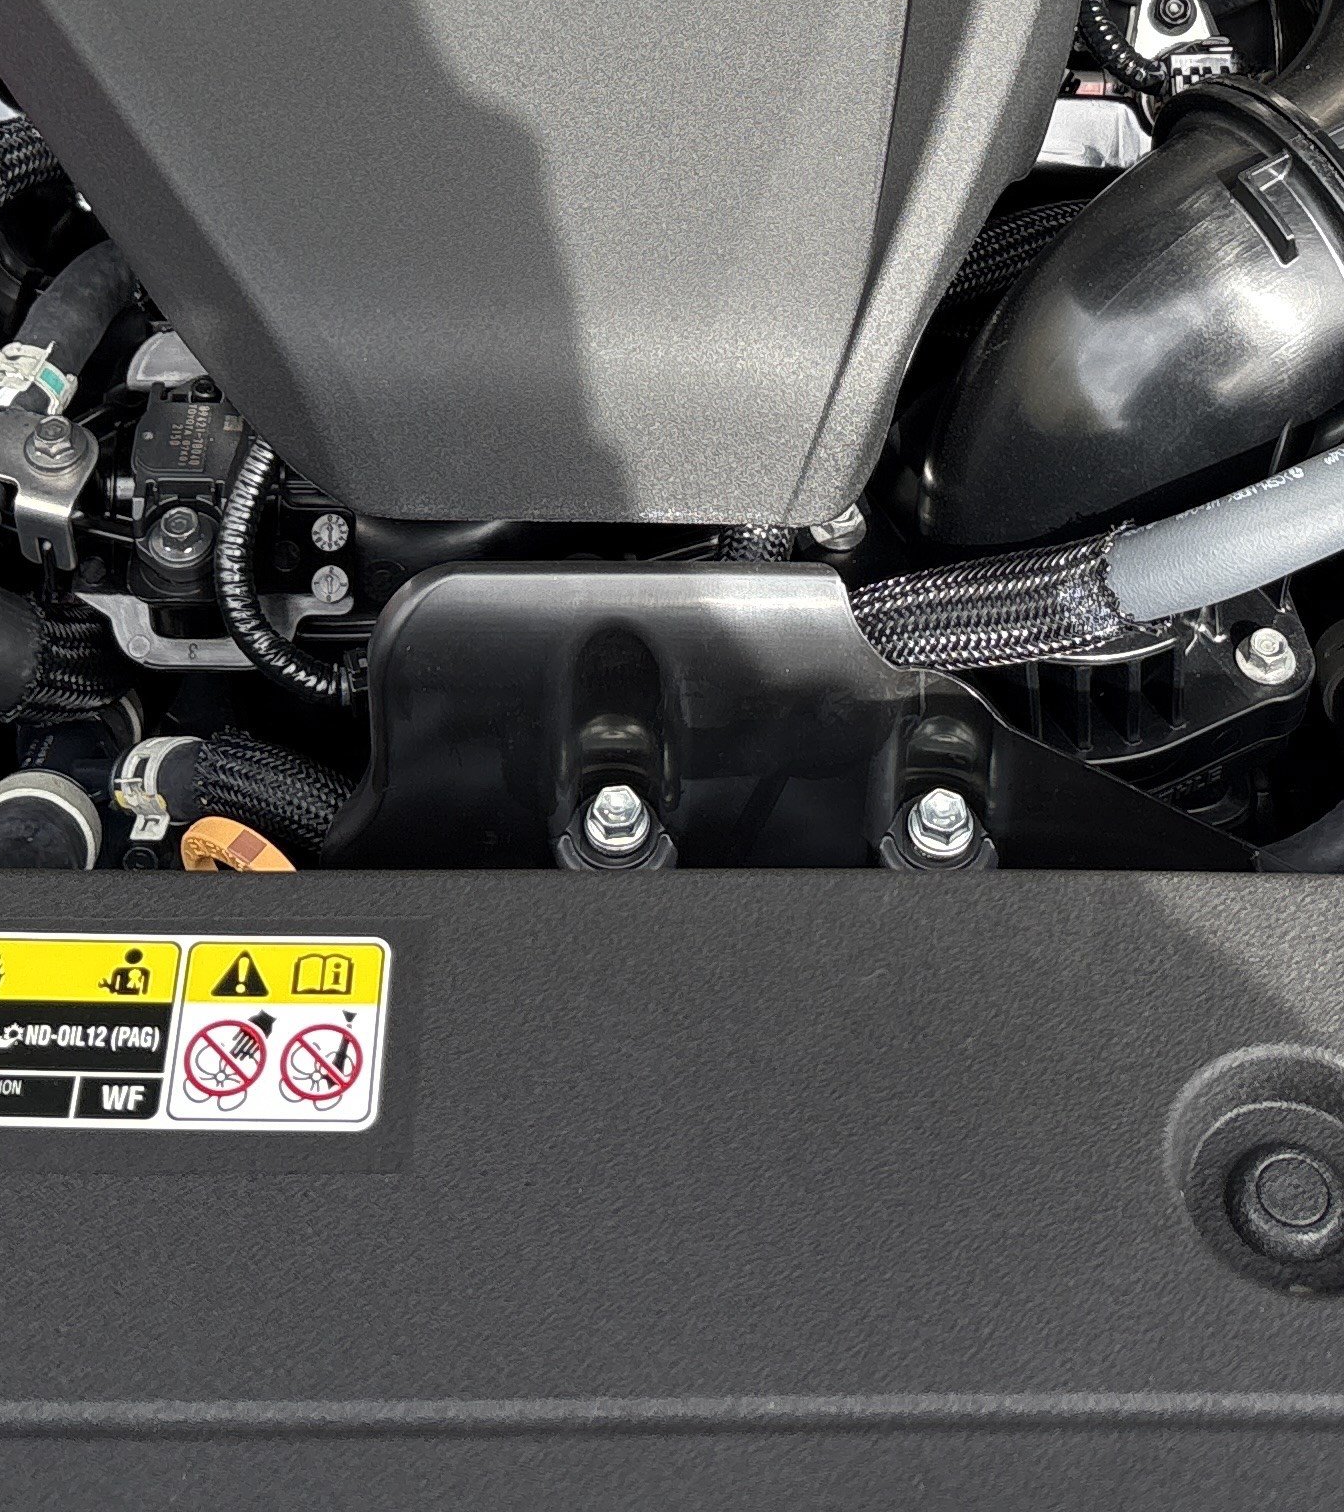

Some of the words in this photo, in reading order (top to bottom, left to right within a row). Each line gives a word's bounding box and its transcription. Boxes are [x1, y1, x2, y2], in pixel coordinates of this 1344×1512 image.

[183, 404, 198, 436] TOYOTA
[23, 1024, 109, 1047] ND-OIL12
[110, 1026, 160, 1052] (PAG)
[102, 1084, 146, 1112] WF
